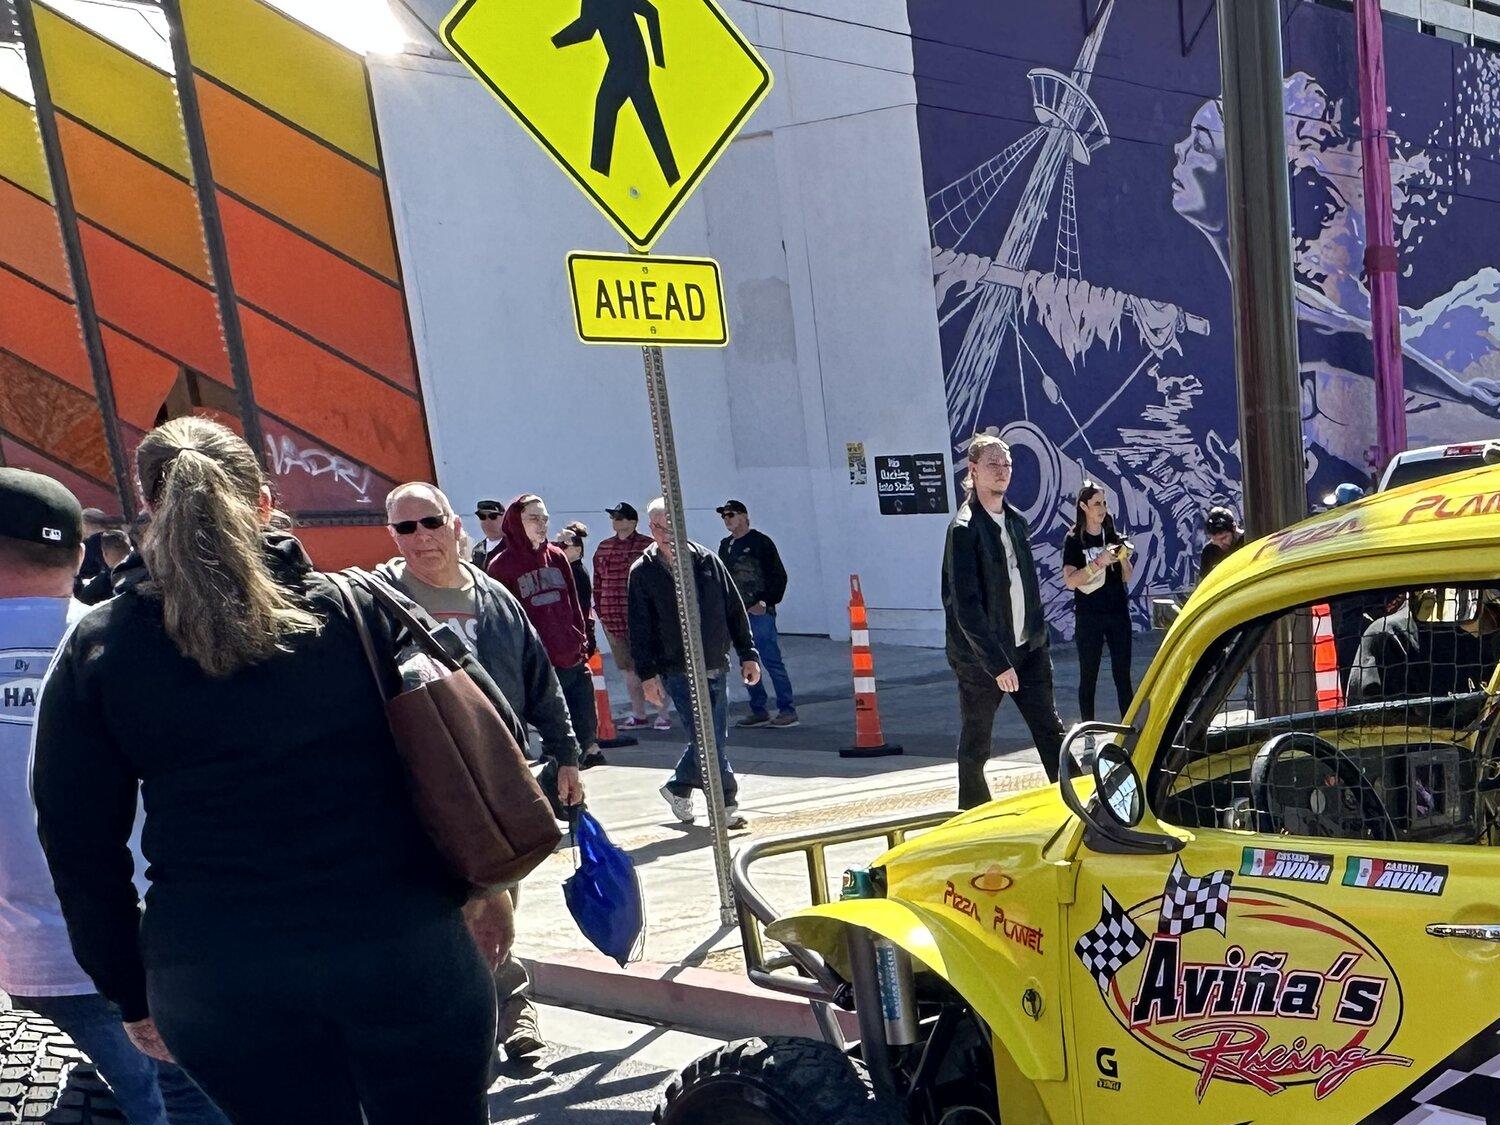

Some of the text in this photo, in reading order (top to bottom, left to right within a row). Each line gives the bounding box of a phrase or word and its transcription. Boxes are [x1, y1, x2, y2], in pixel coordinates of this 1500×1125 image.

[595, 279, 706, 322] AHEAD
[14, 658, 31, 672] By
[4, 686, 39, 708] HA
[1268, 859, 1331, 882] AVIÑA
[1375, 870, 1445, 894] AVIÑA
[993, 904, 1044, 956] PLANET
[1130, 932, 1389, 1030] Aviña's
[1172, 1021, 1414, 1104] Racing
